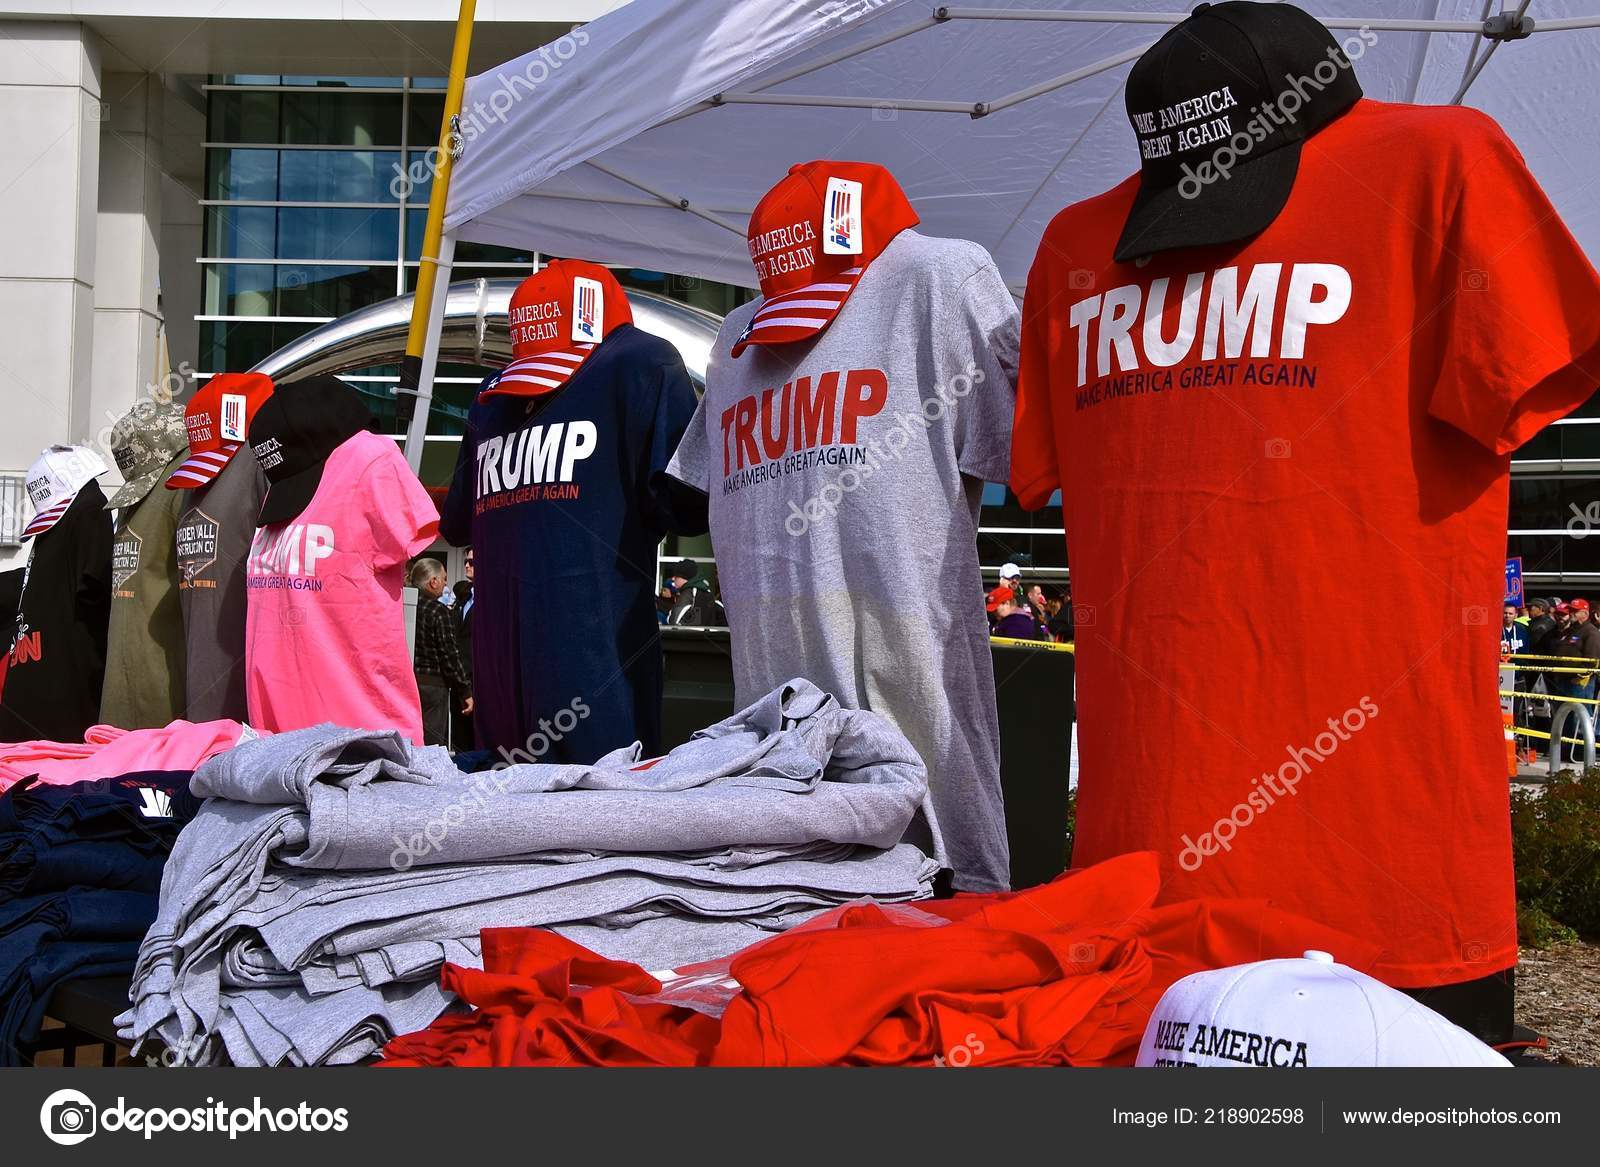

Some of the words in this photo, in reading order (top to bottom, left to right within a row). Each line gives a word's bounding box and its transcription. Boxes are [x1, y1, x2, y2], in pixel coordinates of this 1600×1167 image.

[1159, 86, 1238, 130] AMERICA
[1142, 134, 1172, 159] GREAT
[1177, 115, 1232, 152] AGAIN
[757, 220, 816, 256] AMERICA
[769, 246, 815, 276] AGAIN
[512, 301, 562, 325] AMERICA
[521, 321, 558, 343] AGAIN
[1069, 262, 1353, 388] TRUMP
[1104, 371, 1173, 401] AMERICA
[1179, 363, 1238, 389] GREAT
[1243, 363, 1317, 389] AGAIN
[721, 369, 888, 478] TRUMP
[476, 421, 598, 500] TRUMP
[741, 461, 781, 488] AMERICA
[784, 451, 815, 475] GREAT
[816, 447, 866, 467] AGAIN
[515, 486, 540, 504] GREAT
[542, 484, 579, 500] AGAIN
[247, 524, 335, 577] RUMP
[287, 577, 322, 592] AGAIN
[1154, 1020, 1190, 1051] MAKE
[1188, 1024, 1308, 1067] AMERICA
